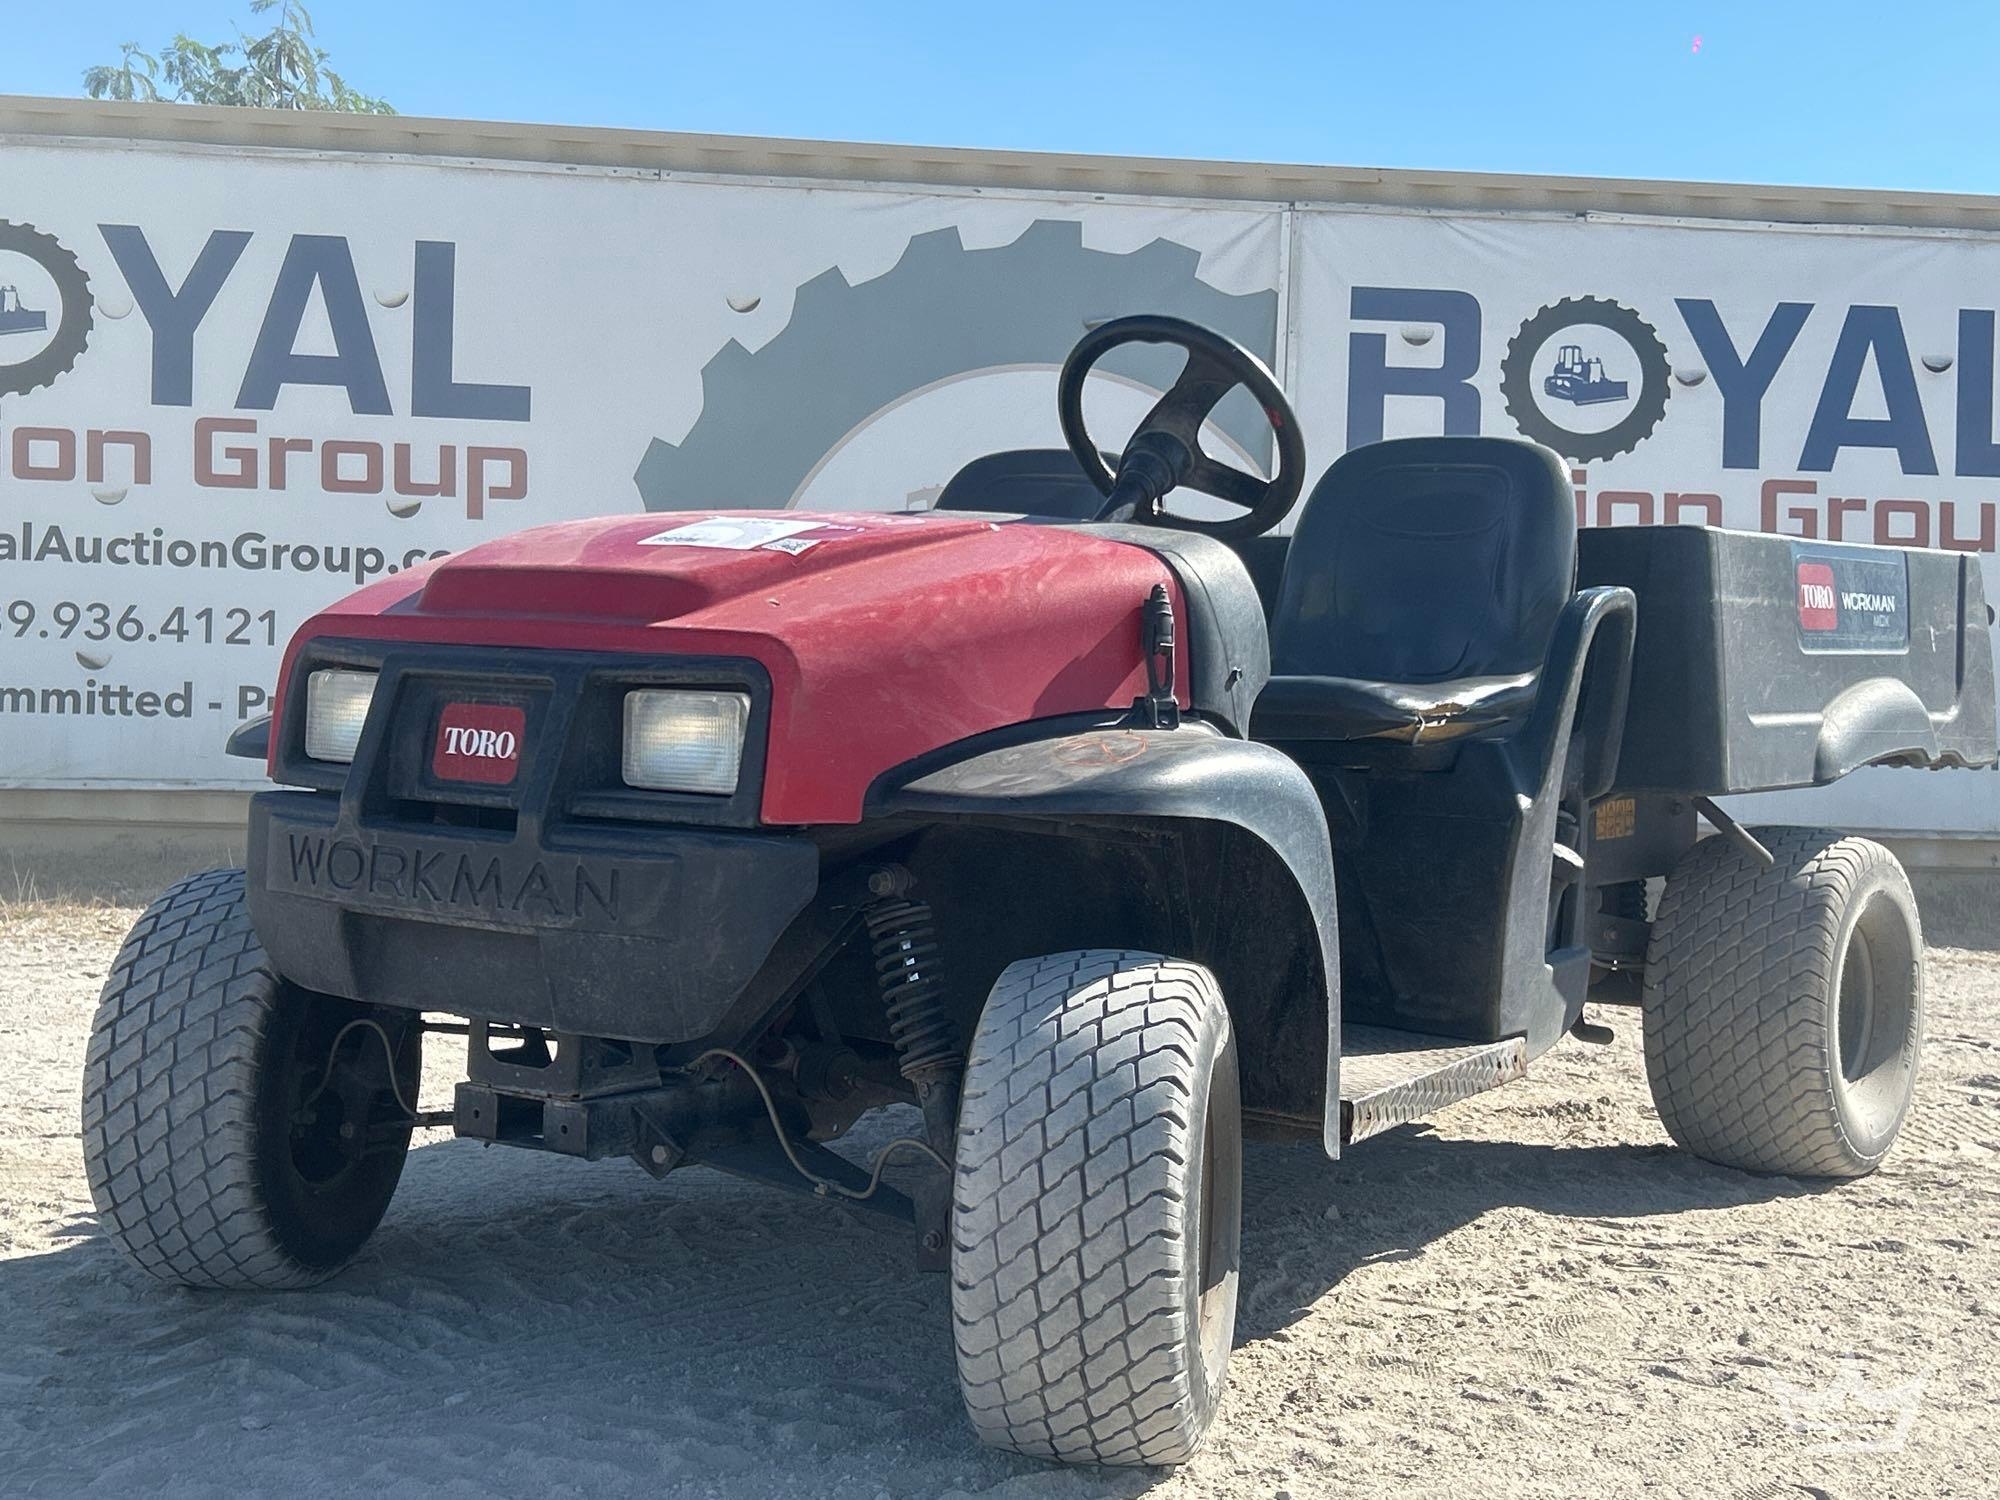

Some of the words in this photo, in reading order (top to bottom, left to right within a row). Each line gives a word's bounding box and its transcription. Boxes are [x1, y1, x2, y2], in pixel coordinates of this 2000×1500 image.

[1346, 285, 2000, 477] ROYAL
[194, 416, 528, 520] Group
[0, 521, 452, 585] alAuctionGroup.c
[0, 599, 276, 646] 9.936.4121
[1801, 584, 1835, 610] TORO
[1841, 592, 1896, 612] WORKMAN
[445, 726, 516, 760] TORO
[287, 832, 620, 923] WORKMAN
